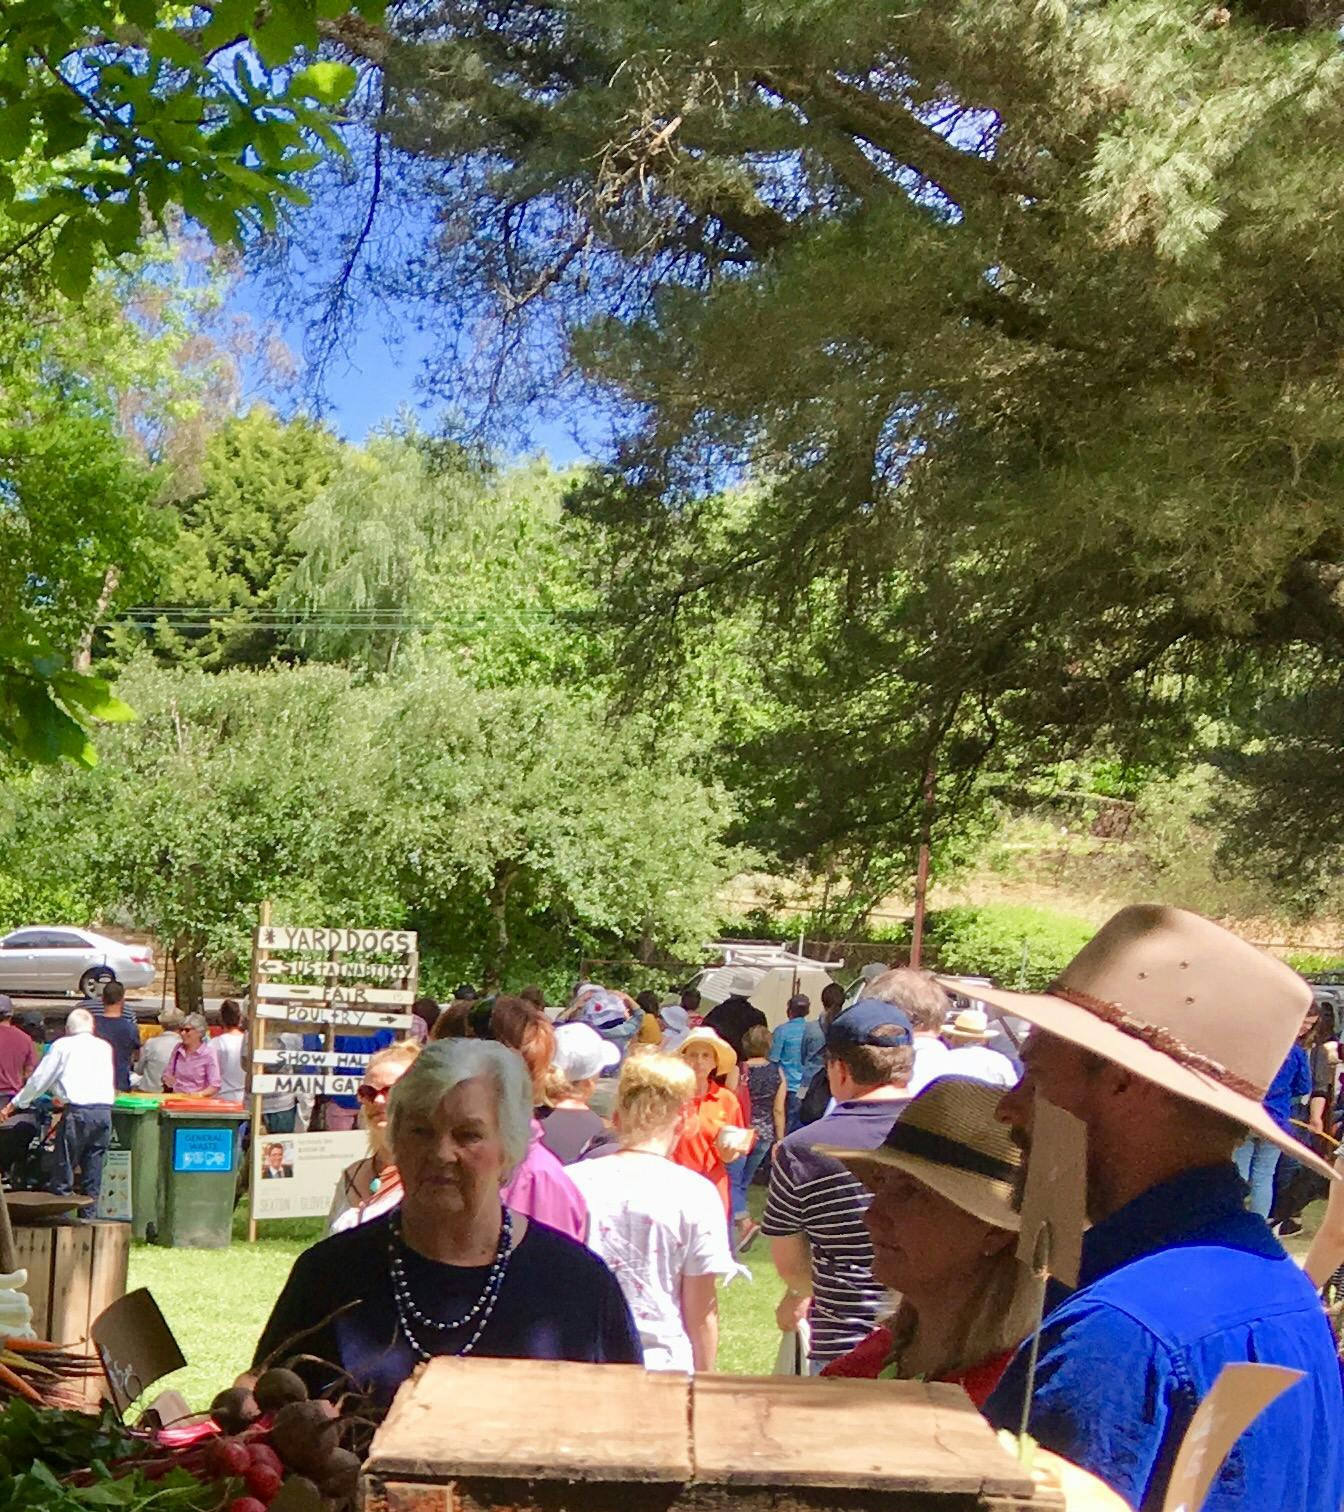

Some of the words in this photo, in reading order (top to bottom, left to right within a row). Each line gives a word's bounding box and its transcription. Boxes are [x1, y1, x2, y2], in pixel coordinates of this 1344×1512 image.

[285, 928, 341, 951] YARD
[346, 930, 410, 953] DOGS
[323, 987, 368, 1003] FAIR
[277, 1051, 326, 1066] SHOW
[337, 1055, 372, 1067] HAL
[274, 1076, 326, 1094] MAIN
[332, 1077, 364, 1093] GAT
